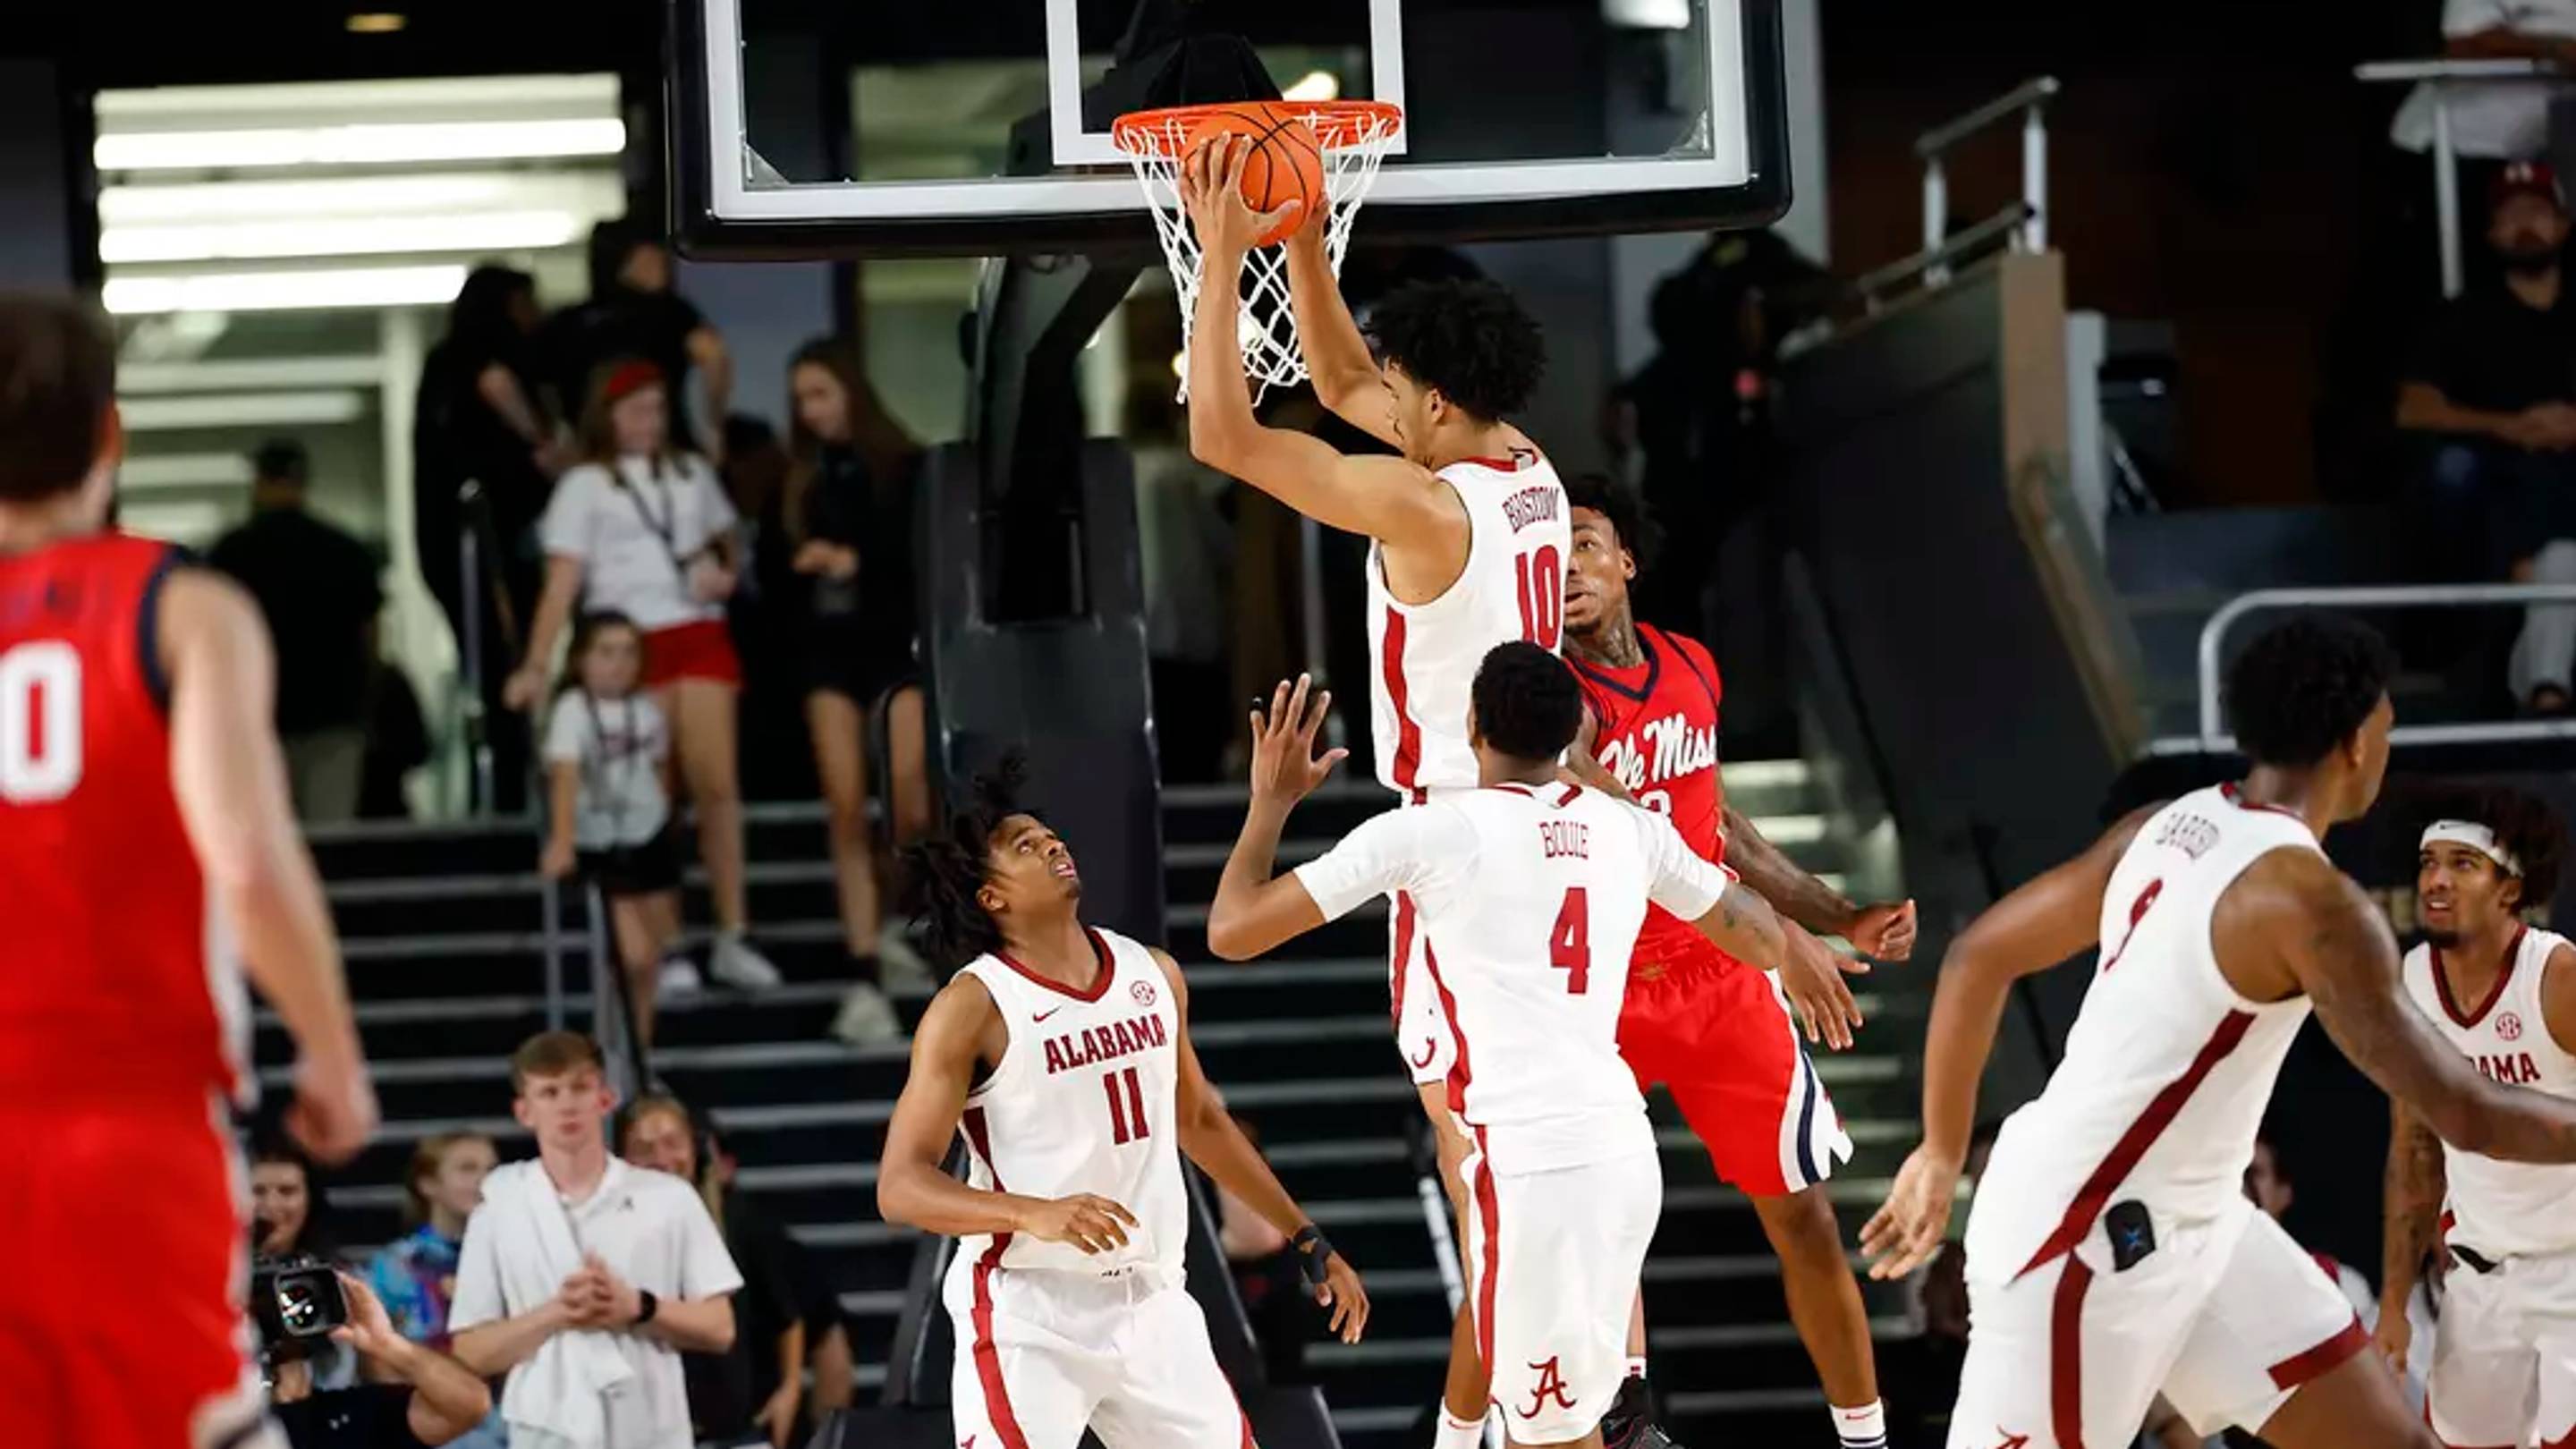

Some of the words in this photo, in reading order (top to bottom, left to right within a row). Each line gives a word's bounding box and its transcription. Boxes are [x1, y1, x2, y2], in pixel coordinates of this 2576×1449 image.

[1515, 544, 1561, 649] 10
[1549, 886, 1591, 995] 4
[1043, 1013, 1167, 1074] ALABAMA
[1103, 1066, 1149, 1146] 11
[1515, 1355, 1578, 1419] A
